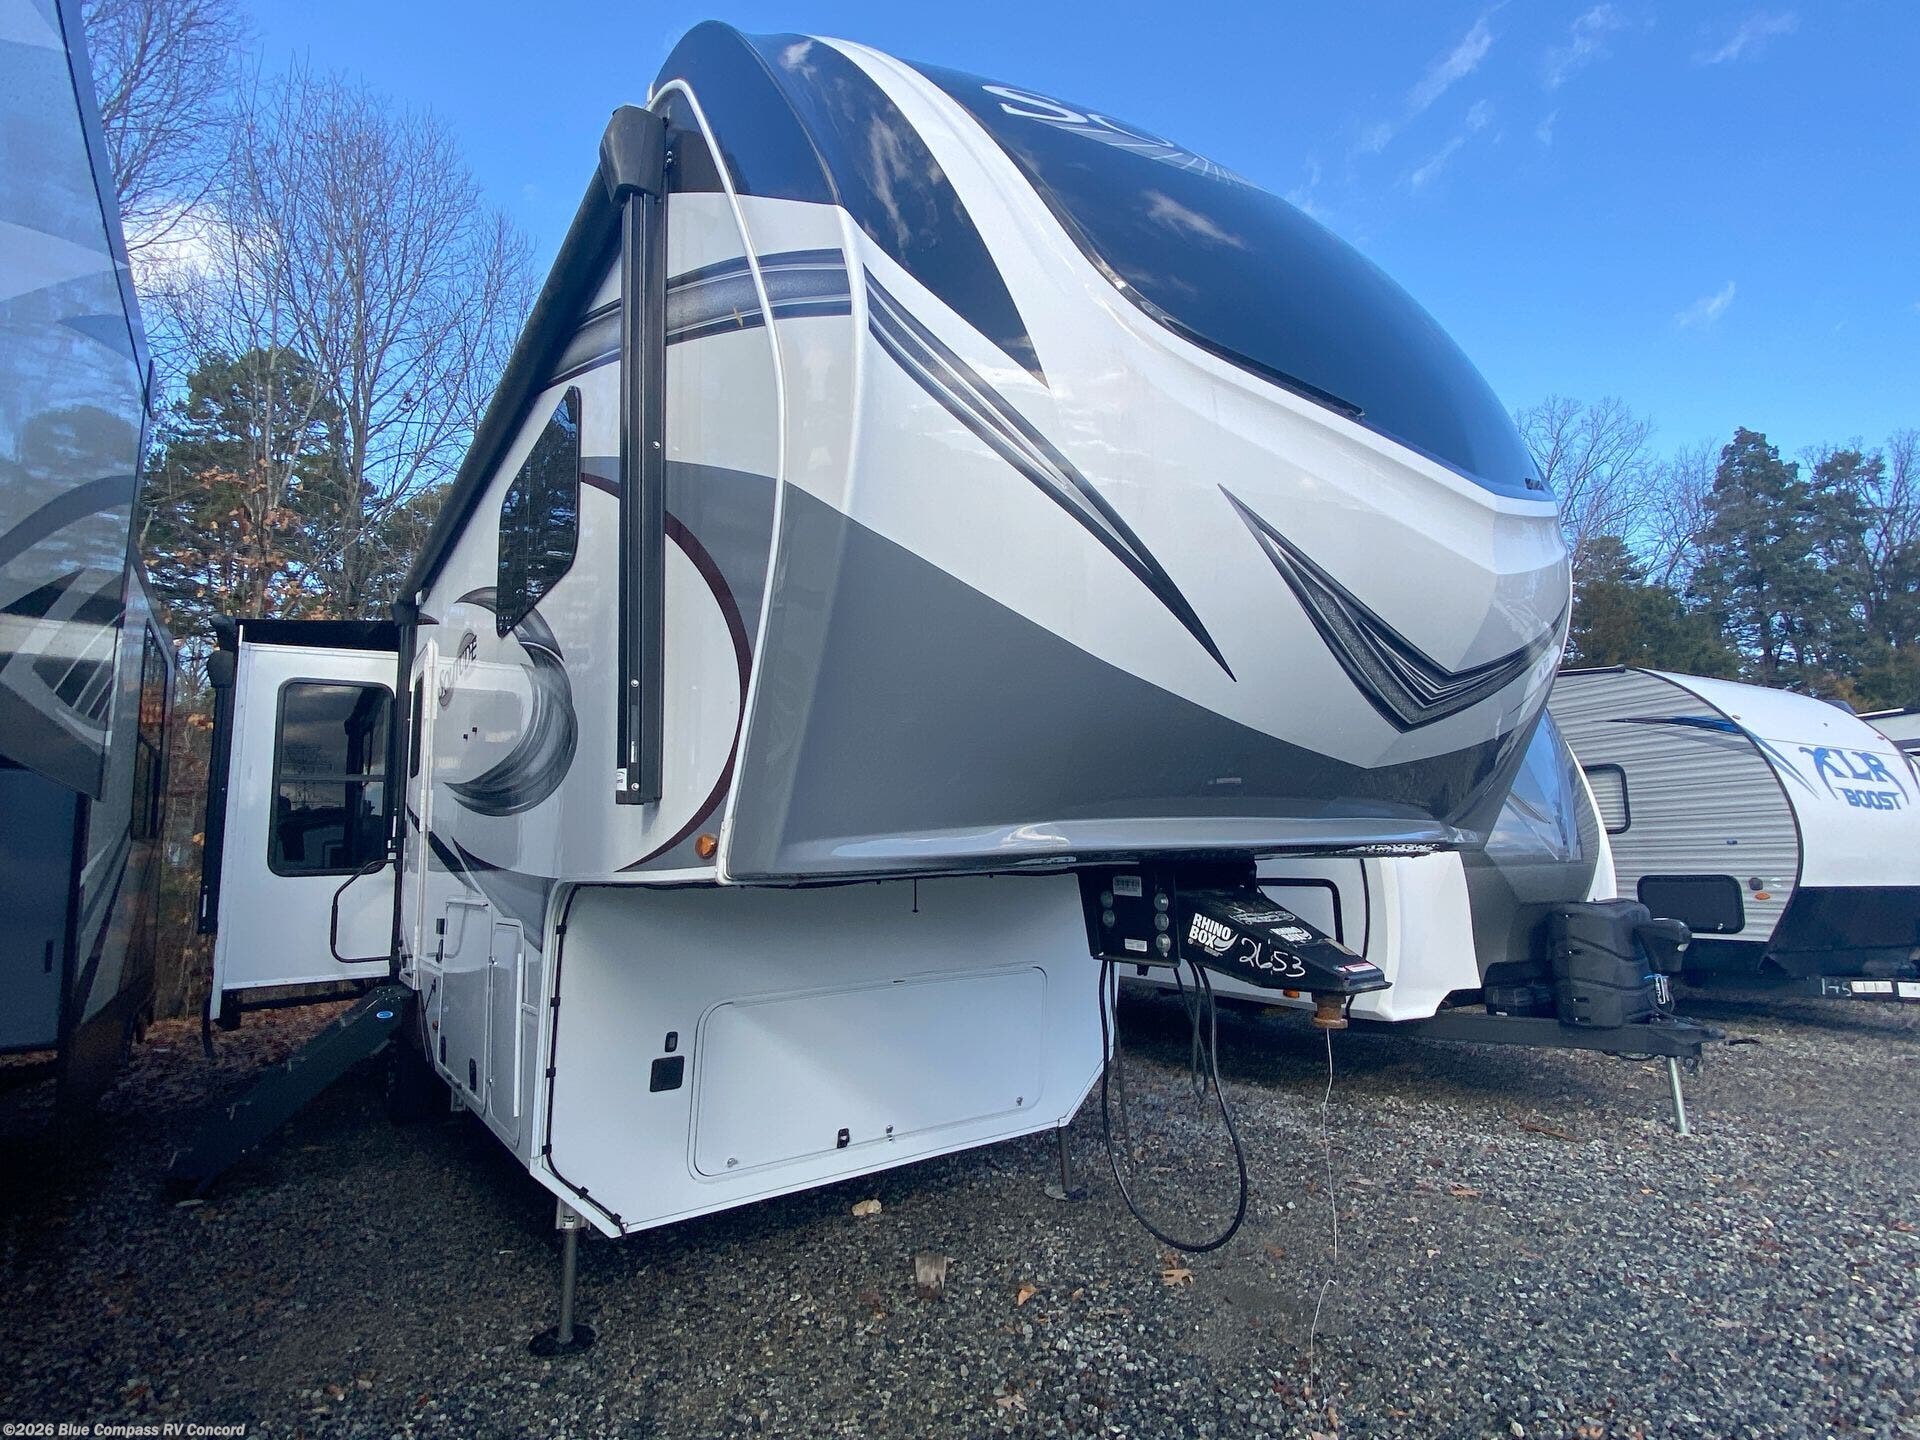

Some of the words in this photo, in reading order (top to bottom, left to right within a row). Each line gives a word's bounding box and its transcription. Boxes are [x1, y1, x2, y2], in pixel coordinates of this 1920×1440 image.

[1799, 746, 1909, 804] XLR
[1834, 787, 1901, 810] BOOST
[1189, 924, 1217, 949] BOX
[1192, 912, 1232, 941] RHINO
[1239, 937, 1306, 978] 2653
